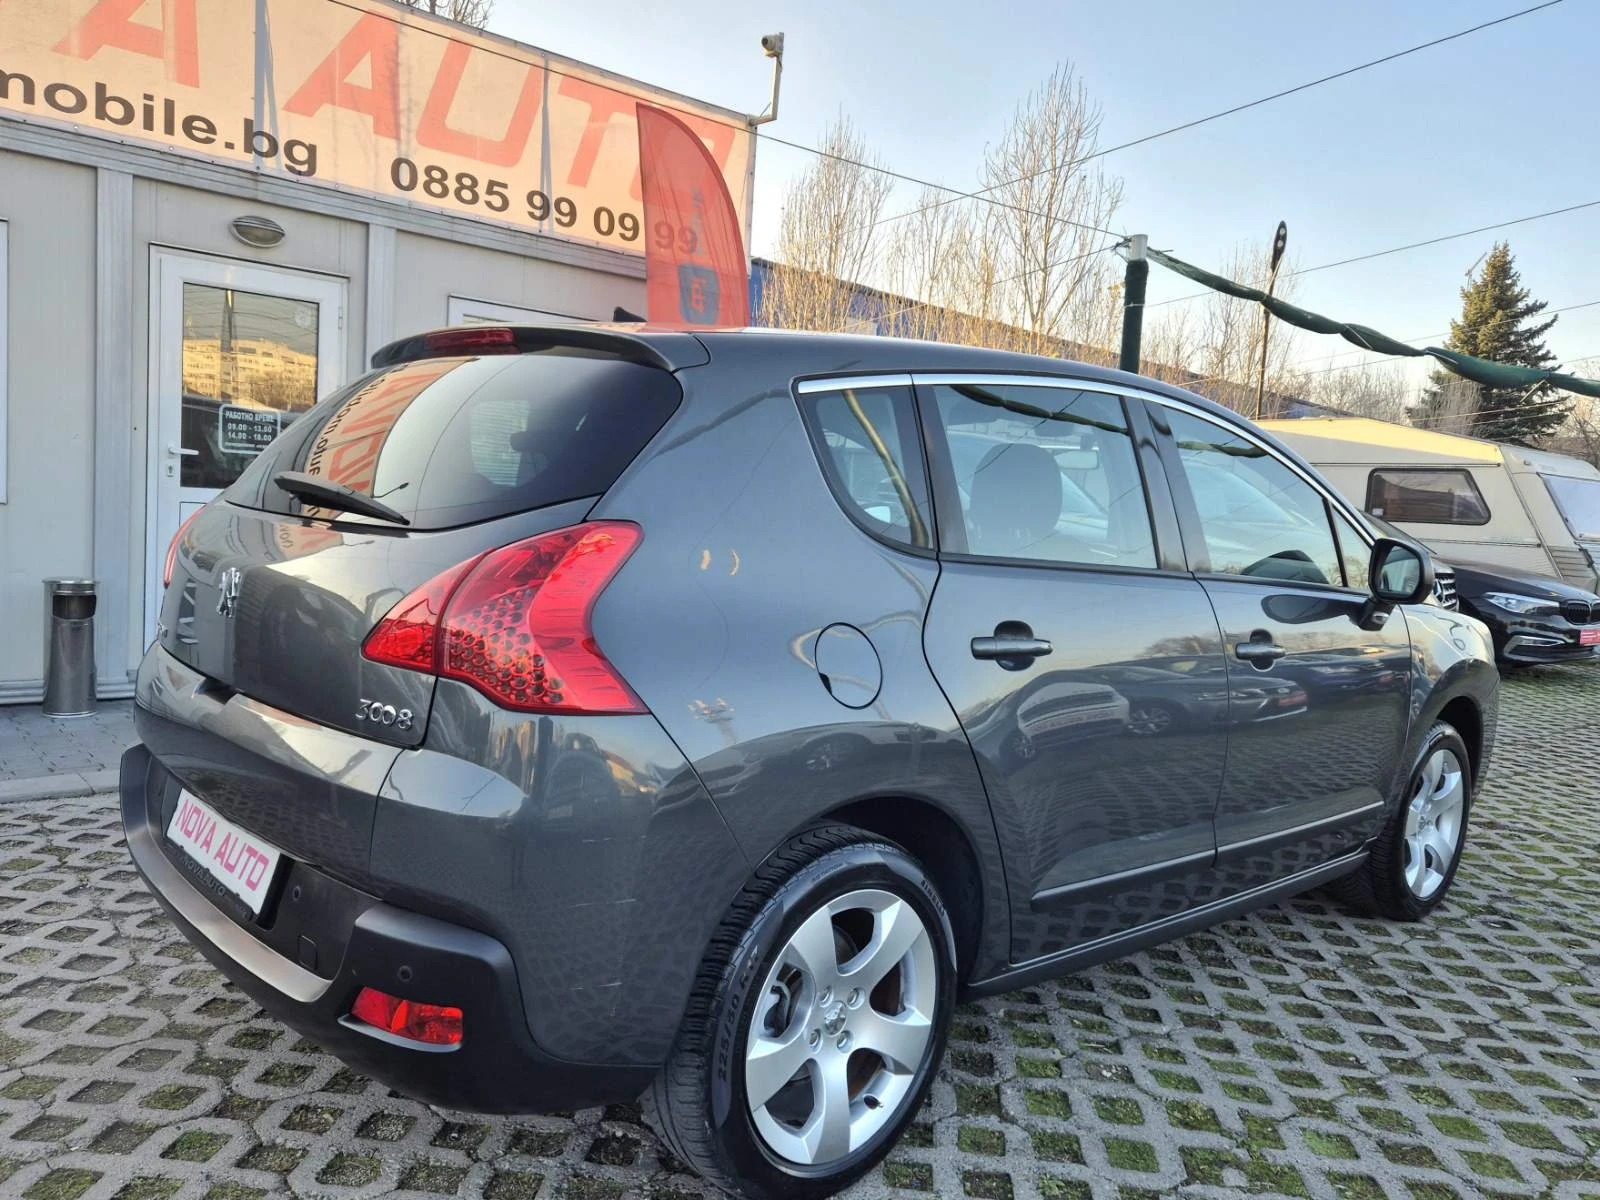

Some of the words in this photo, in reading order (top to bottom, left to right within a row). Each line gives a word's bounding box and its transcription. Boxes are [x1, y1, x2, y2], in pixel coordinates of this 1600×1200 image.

[390, 157, 510, 213] 0885
[526, 190, 578, 228] 99
[593, 206, 640, 242] 09
[654, 221, 699, 254] 99
[354, 697, 414, 731] 3008
[175, 798, 218, 854] NOVA
[213, 831, 271, 892] AUTO
